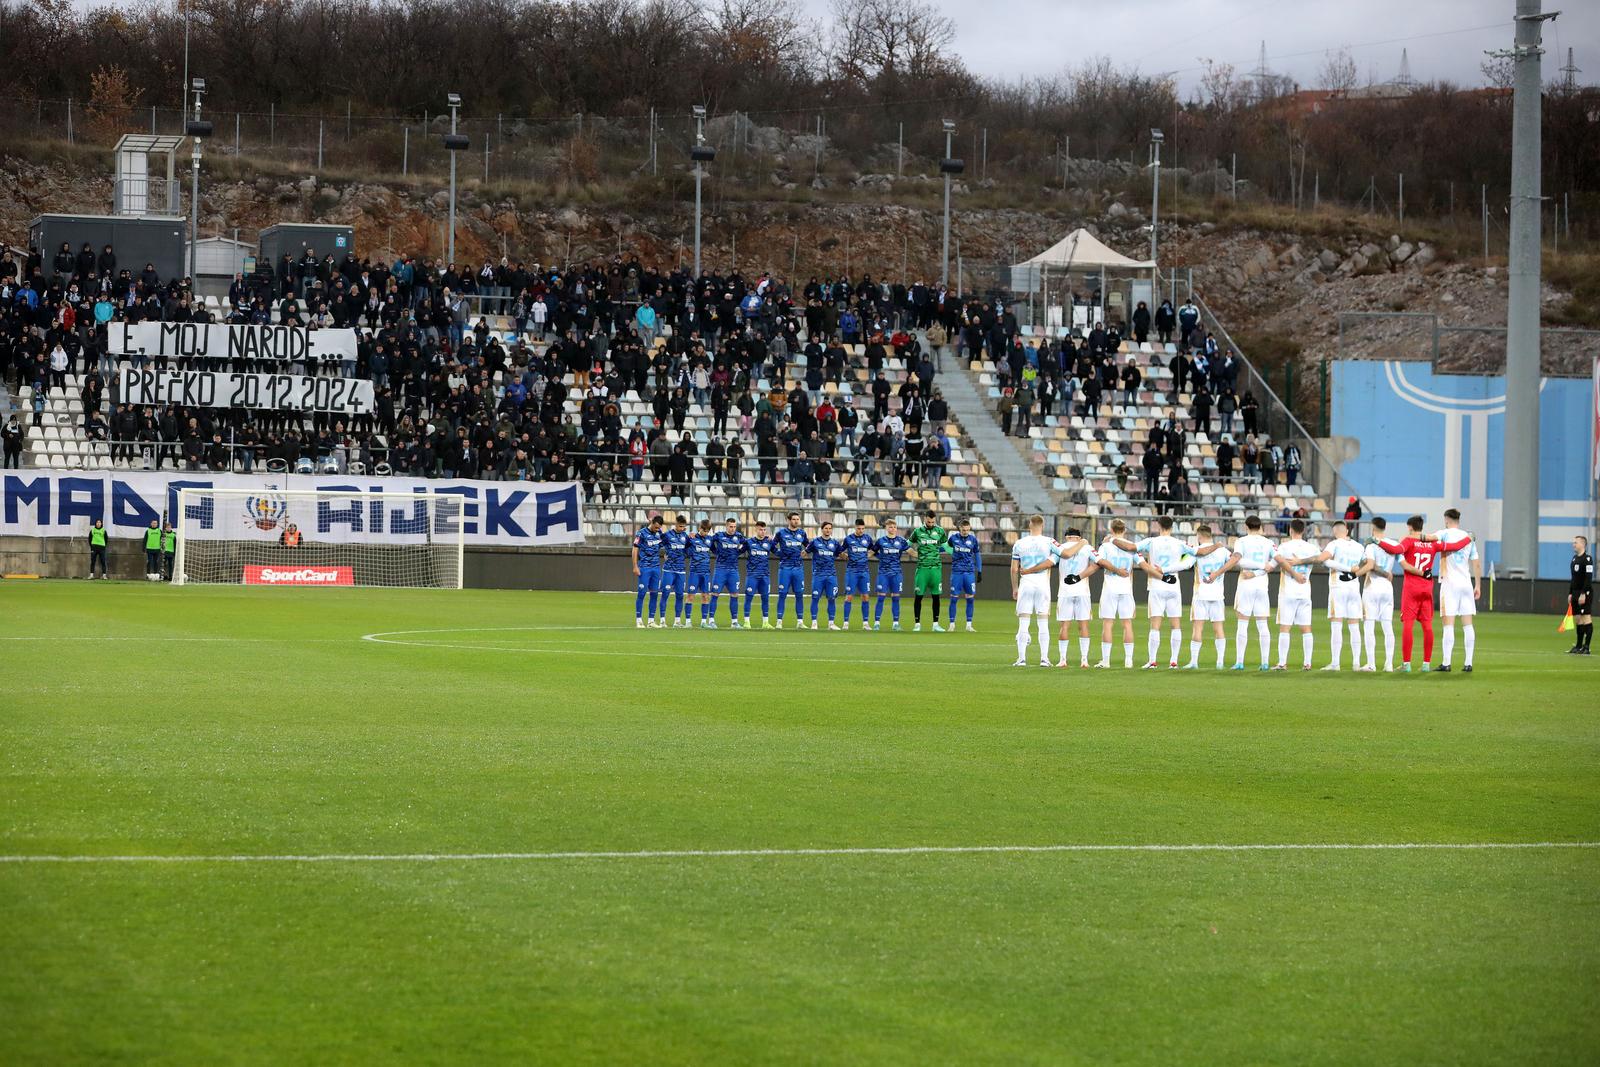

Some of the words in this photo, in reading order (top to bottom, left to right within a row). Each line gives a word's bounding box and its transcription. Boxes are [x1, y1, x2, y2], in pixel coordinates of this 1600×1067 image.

[160, 323, 209, 357] MOJ
[228, 326, 344, 361] NARODE...
[125, 369, 215, 406] PREČKO
[230, 374, 371, 413] 20.12.2024.
[317, 484, 580, 538] RIJEKA
[1159, 554, 1170, 568] 2
[1413, 552, 1431, 571] 12
[260, 568, 339, 584] SportCard
